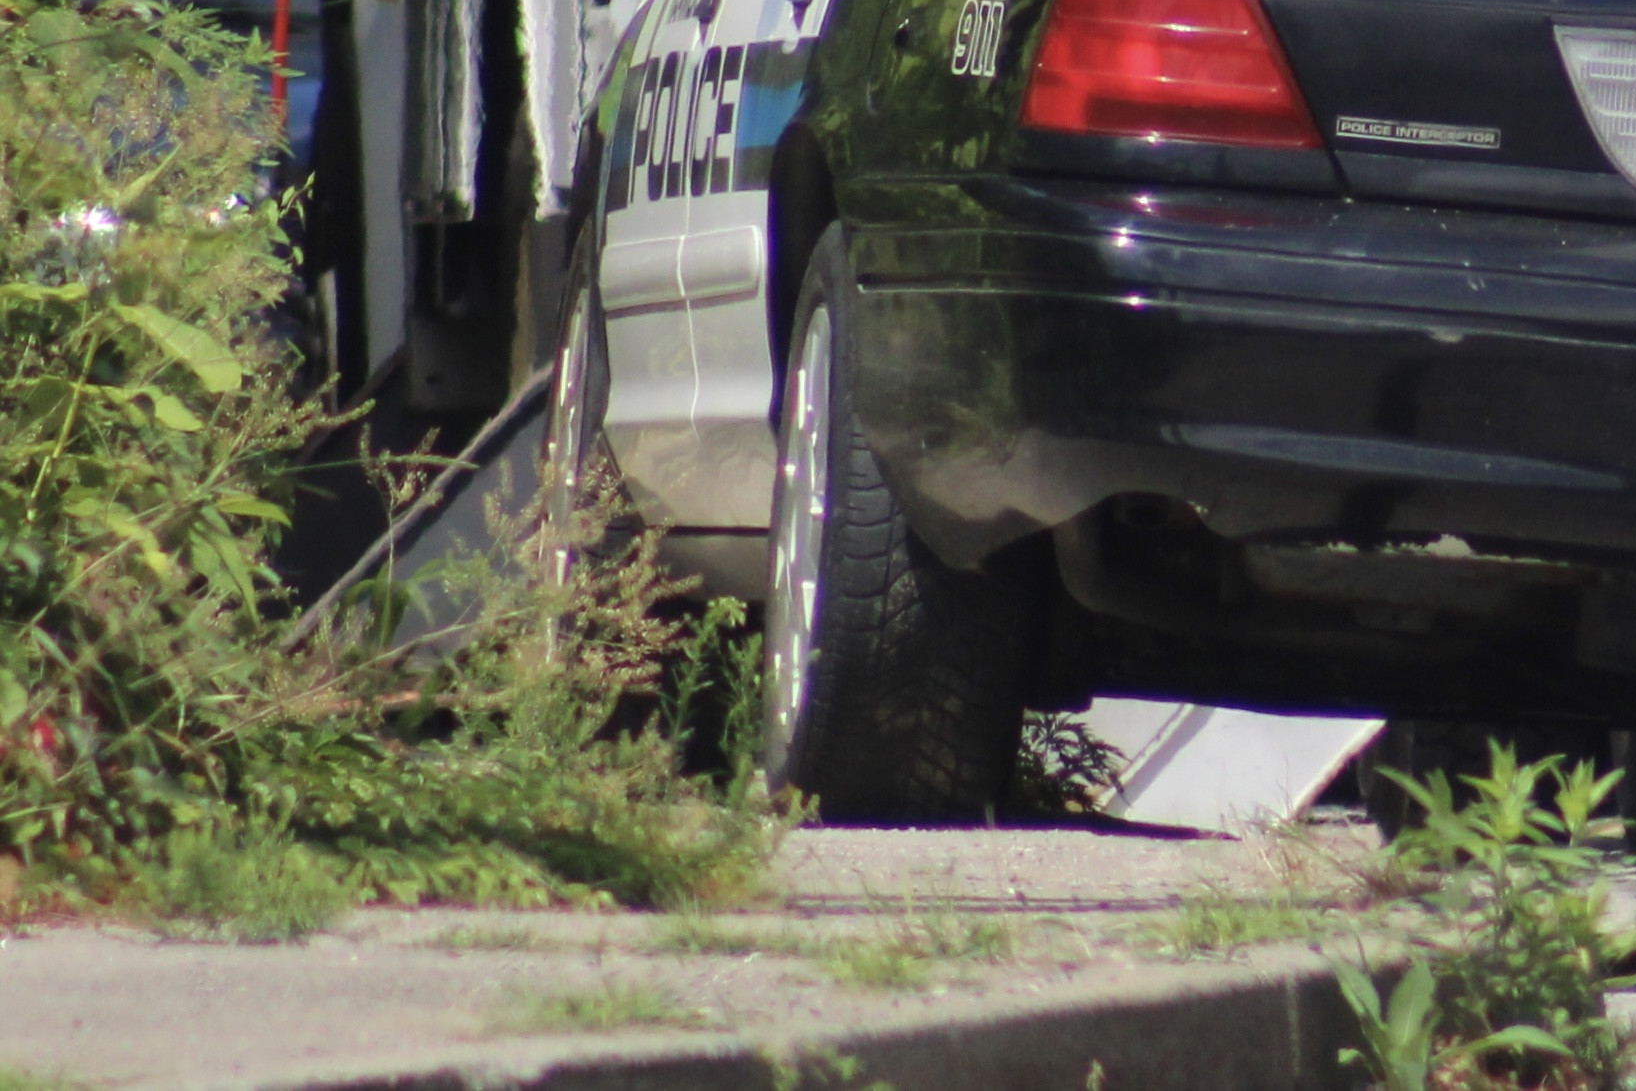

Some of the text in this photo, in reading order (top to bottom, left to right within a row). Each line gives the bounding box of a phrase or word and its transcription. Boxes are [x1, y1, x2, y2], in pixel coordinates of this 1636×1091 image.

[630, 46, 744, 203] POLICE
[1340, 121, 1496, 143] POLICE INTERCEPTOR
